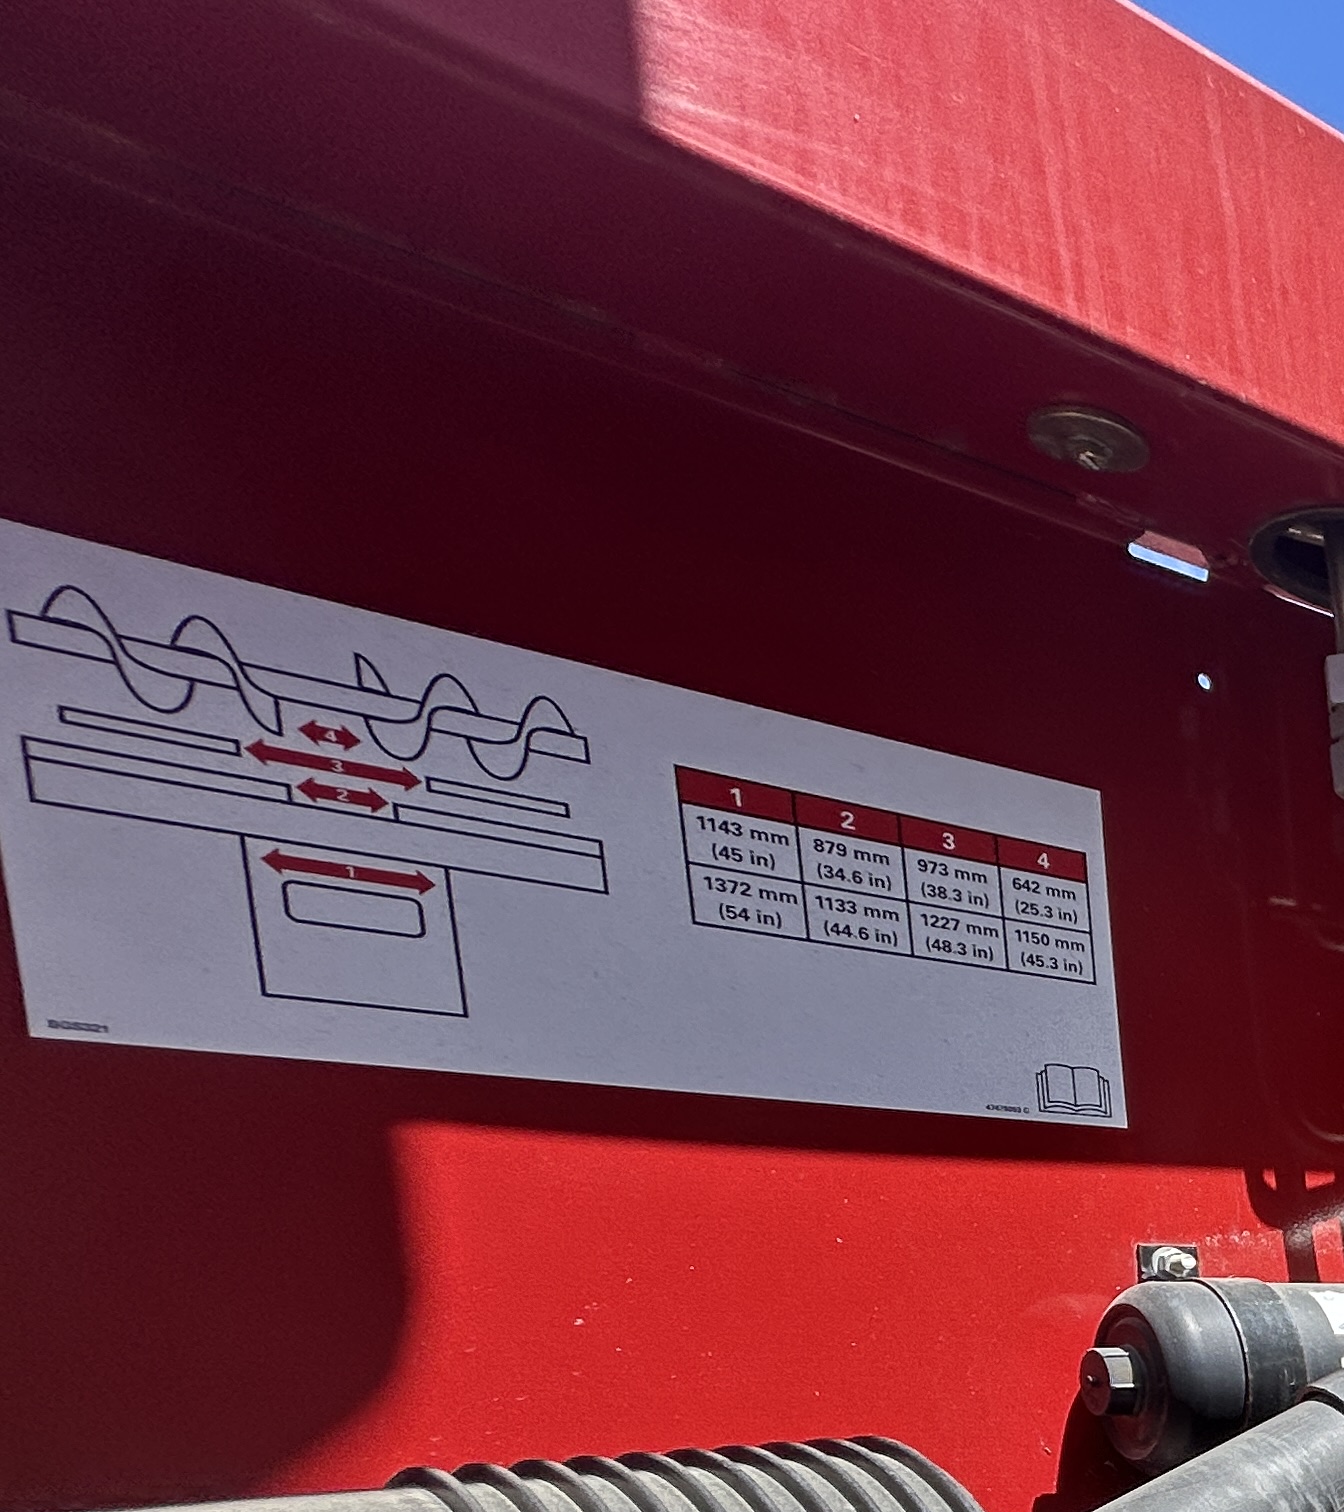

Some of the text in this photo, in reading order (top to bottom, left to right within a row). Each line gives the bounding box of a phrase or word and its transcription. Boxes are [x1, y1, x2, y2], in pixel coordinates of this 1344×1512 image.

[324, 730, 338, 742] 4
[331, 760, 345, 773] 3
[336, 788, 350, 801] 2
[728, 787, 743, 807] 1
[696, 815, 790, 847] 1143 mm
[839, 811, 856, 831] 2
[812, 838, 890, 866] 879 mm
[941, 832, 956, 851] 3
[711, 842, 776, 871] (45 in)
[1036, 852, 1051, 870] 4
[344, 866, 355, 879] 1
[816, 862, 893, 892] (34.6 in)
[916, 858, 988, 884] 973 mm
[702, 875, 799, 905] 1372 mm
[920, 881, 990, 910] (38.3 in)
[1011, 877, 1077, 901] 642 mm
[718, 902, 783, 930] (54 in)
[814, 895, 900, 923] 1133 mm
[1014, 899, 1078, 926] (25.3 in)
[823, 919, 899, 948] (44.6 in)
[920, 913, 1000, 939] 1227 mm
[925, 936, 995, 962] (48.3 in)
[1014, 929, 1086, 953] 1150 mm
[1020, 951, 1084, 977] (45.3 in)
